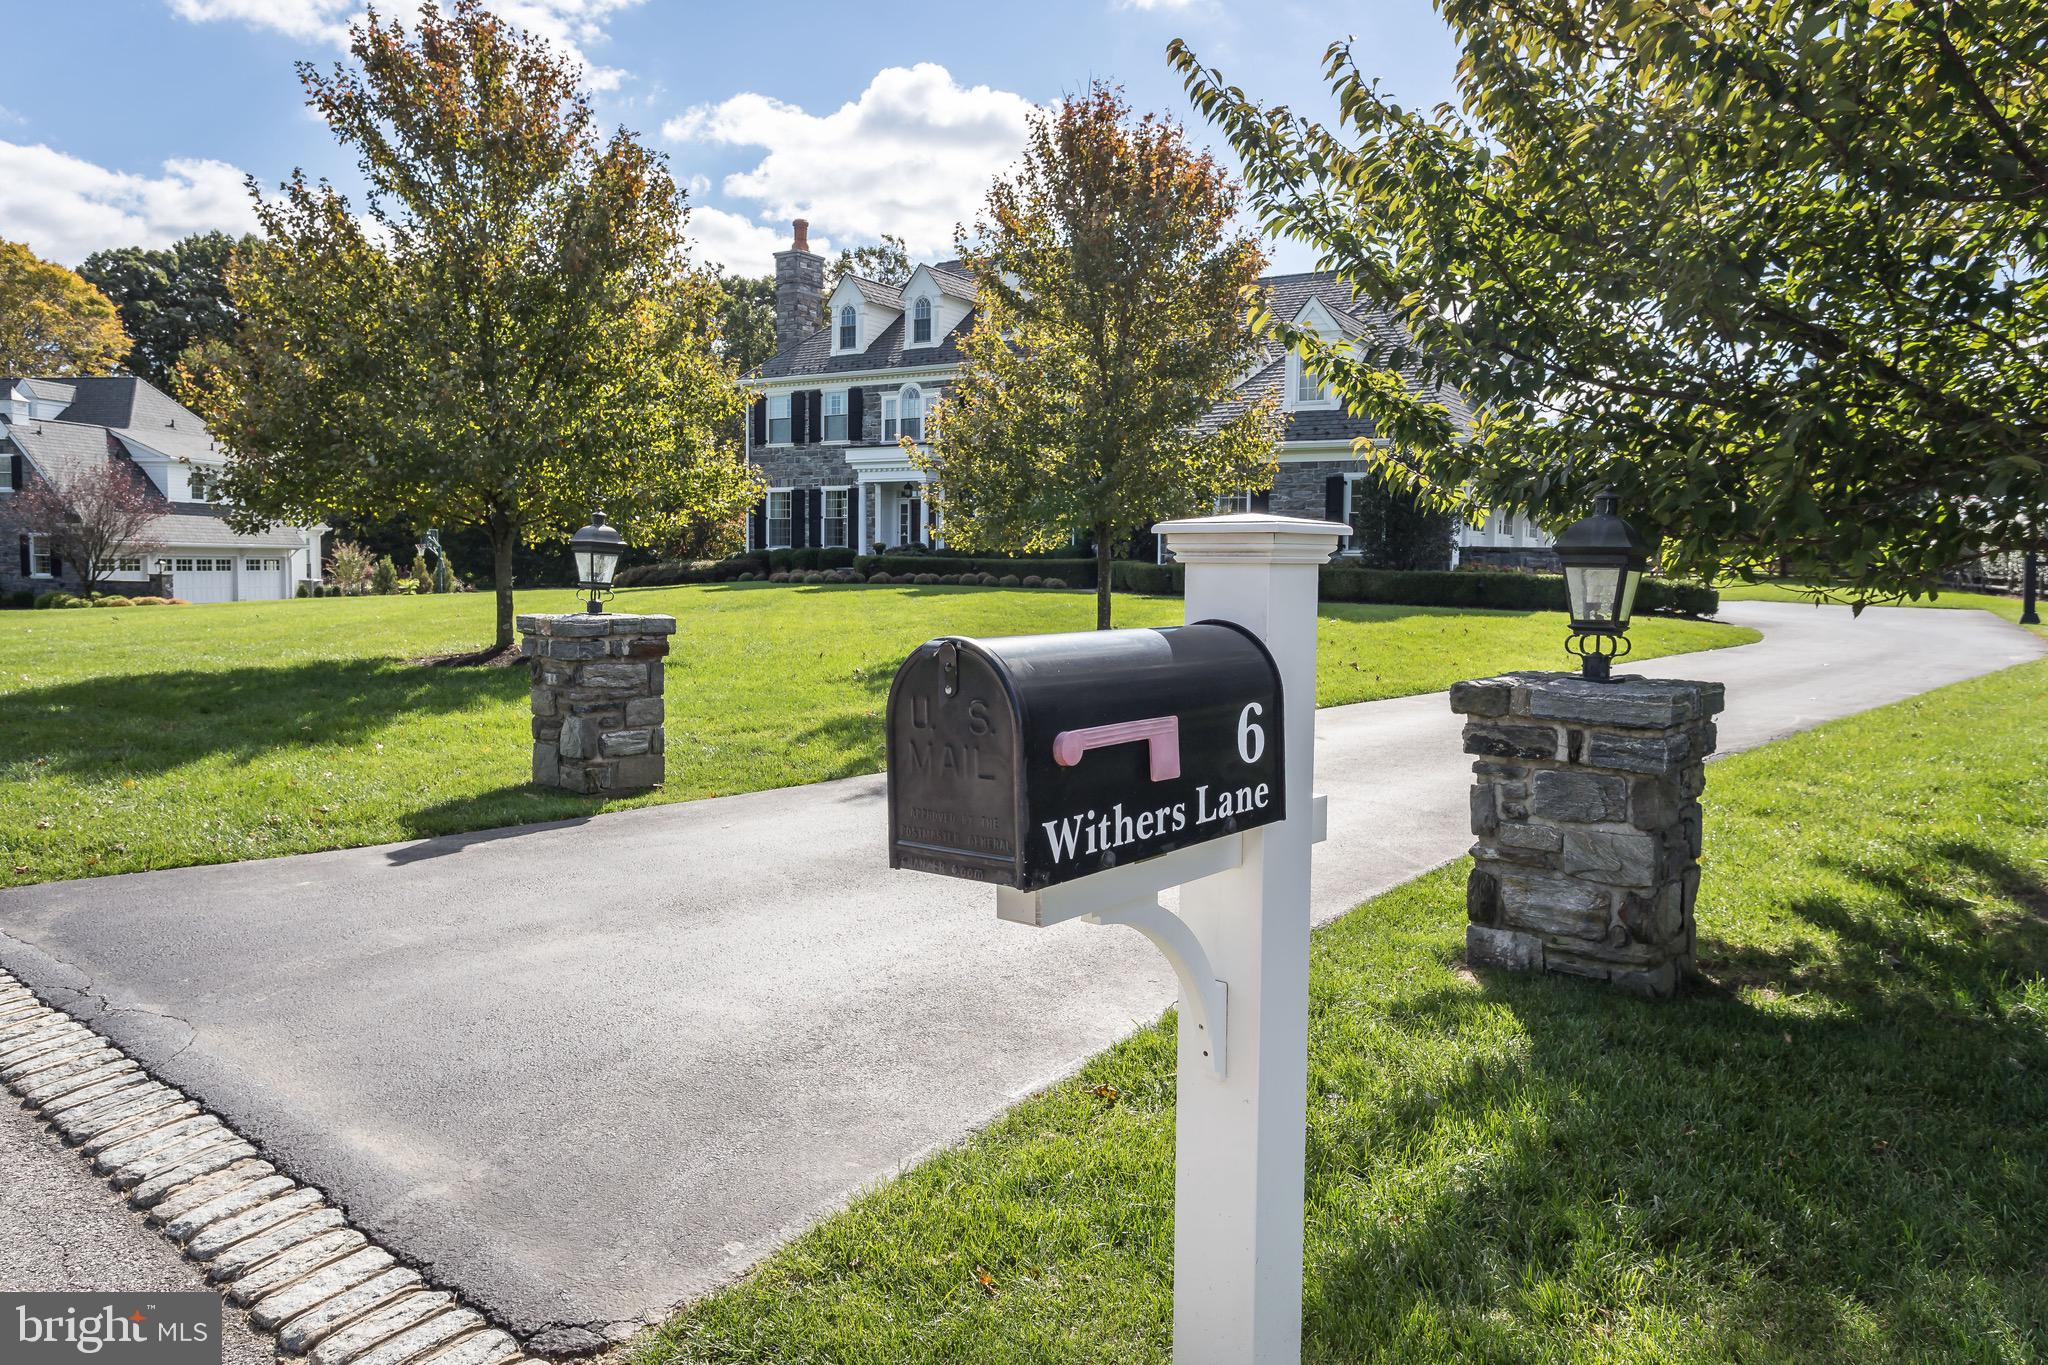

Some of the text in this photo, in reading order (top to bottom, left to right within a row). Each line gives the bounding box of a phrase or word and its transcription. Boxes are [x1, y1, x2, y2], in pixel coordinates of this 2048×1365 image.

[1237, 702, 1265, 764] 6
[908, 739, 996, 781] MAIL
[981, 815, 1000, 831] THE
[1042, 782, 1269, 864] Withers Lane
